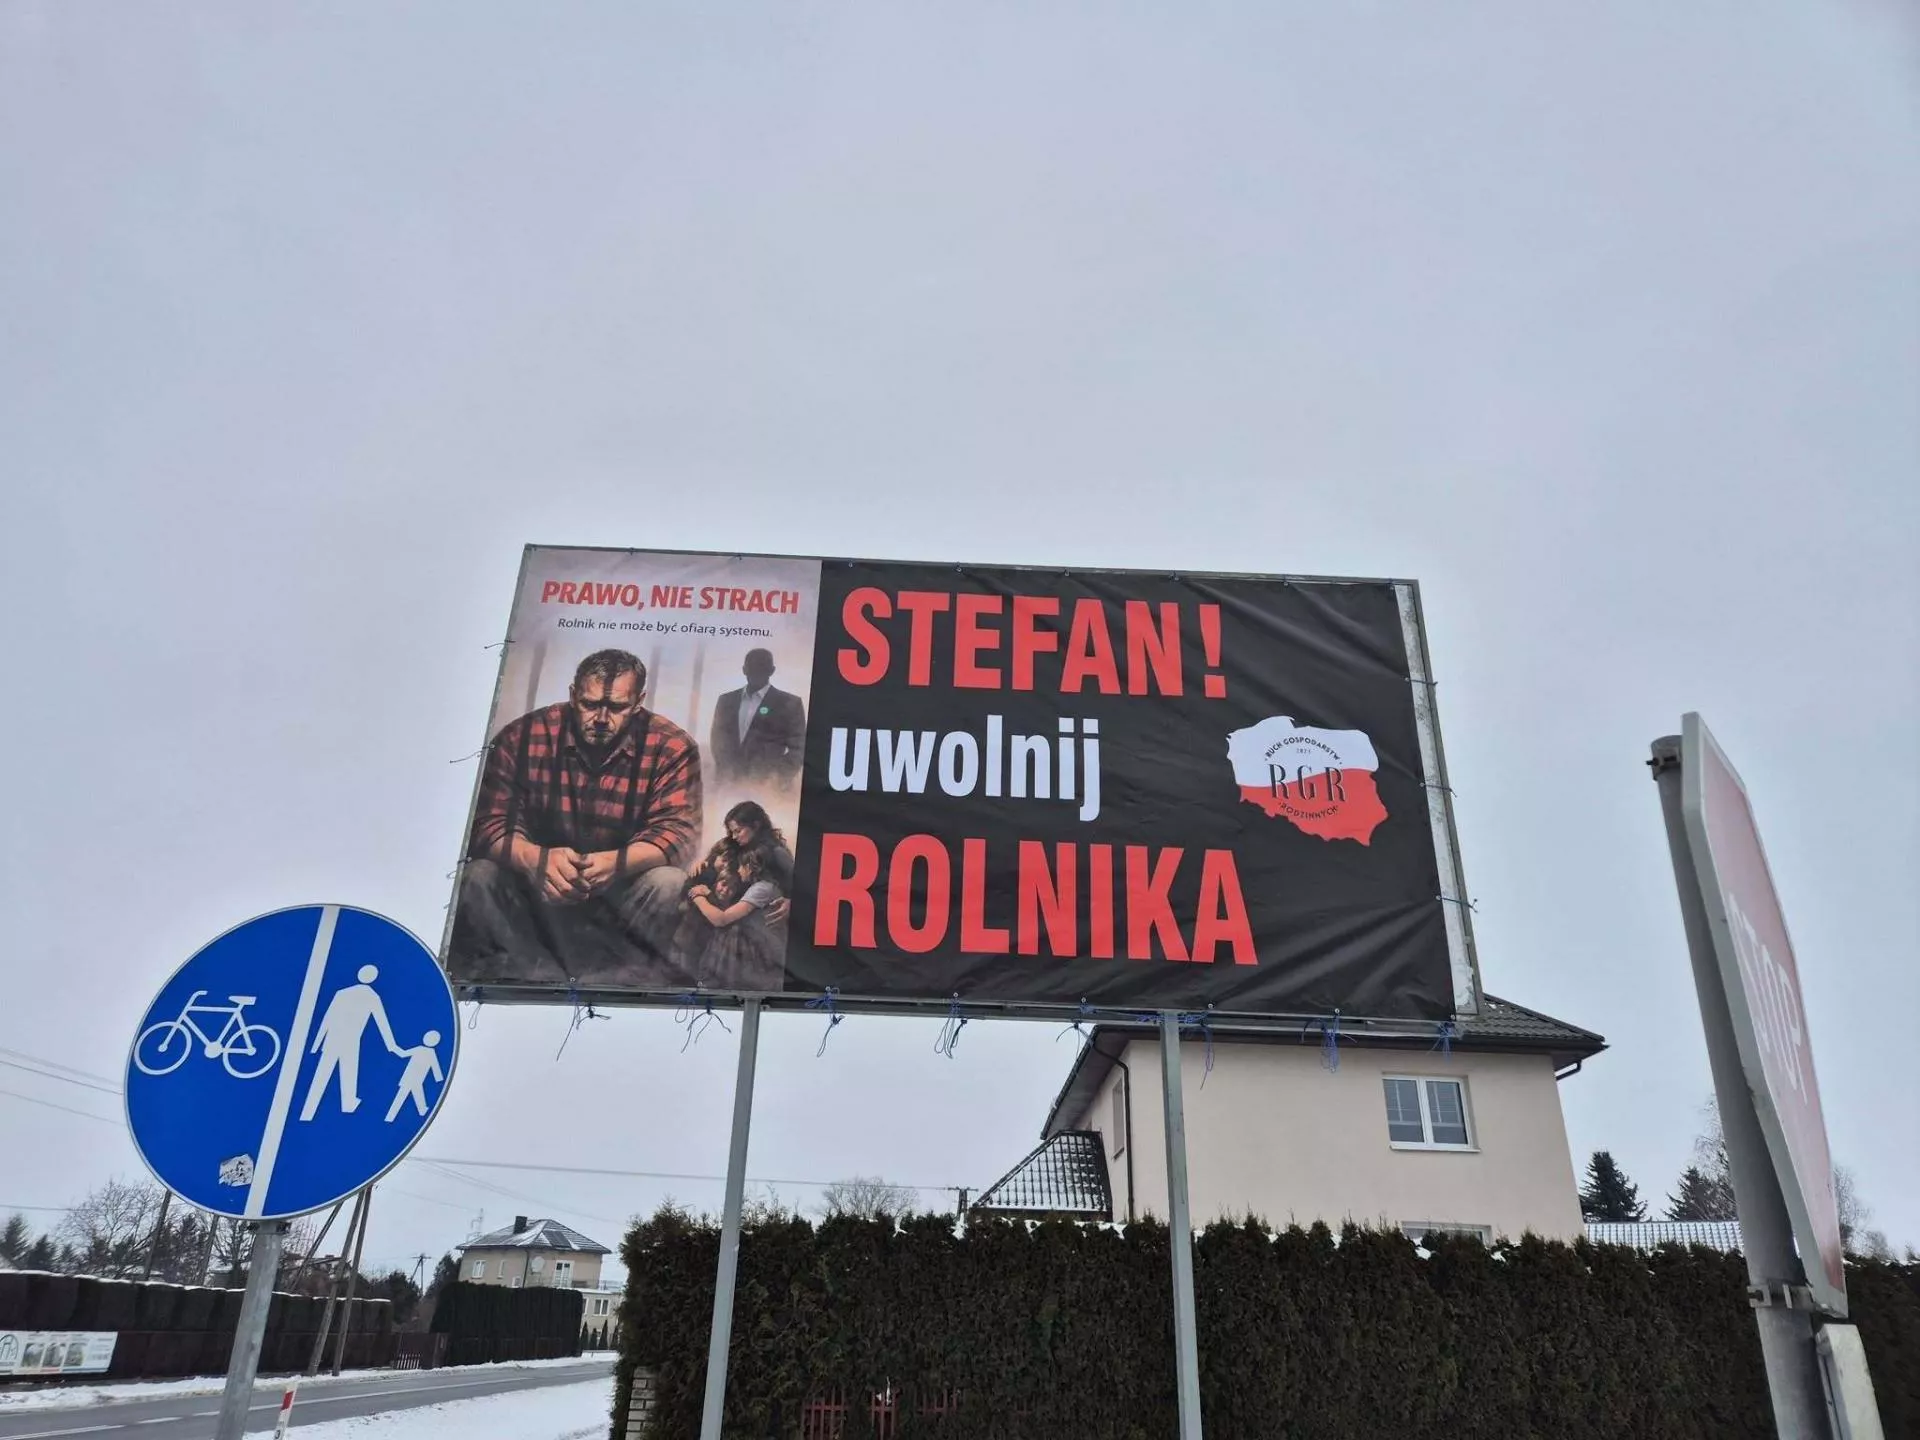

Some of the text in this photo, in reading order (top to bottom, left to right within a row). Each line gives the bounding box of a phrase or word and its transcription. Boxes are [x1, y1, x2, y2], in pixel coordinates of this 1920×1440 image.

[541, 580, 799, 614] PRAWO, NIE STRACH
[557, 617, 774, 638] Rolnik nie może być ofiarą systemu.
[1265, 736, 1341, 761] RUCH GOSPODARSTW
[828, 714, 1101, 822] uwolnij
[1267, 763, 1345, 802] RGR
[1280, 802, 1339, 819] RODZINNYCH
[814, 833, 1258, 965] ROLNIKA
